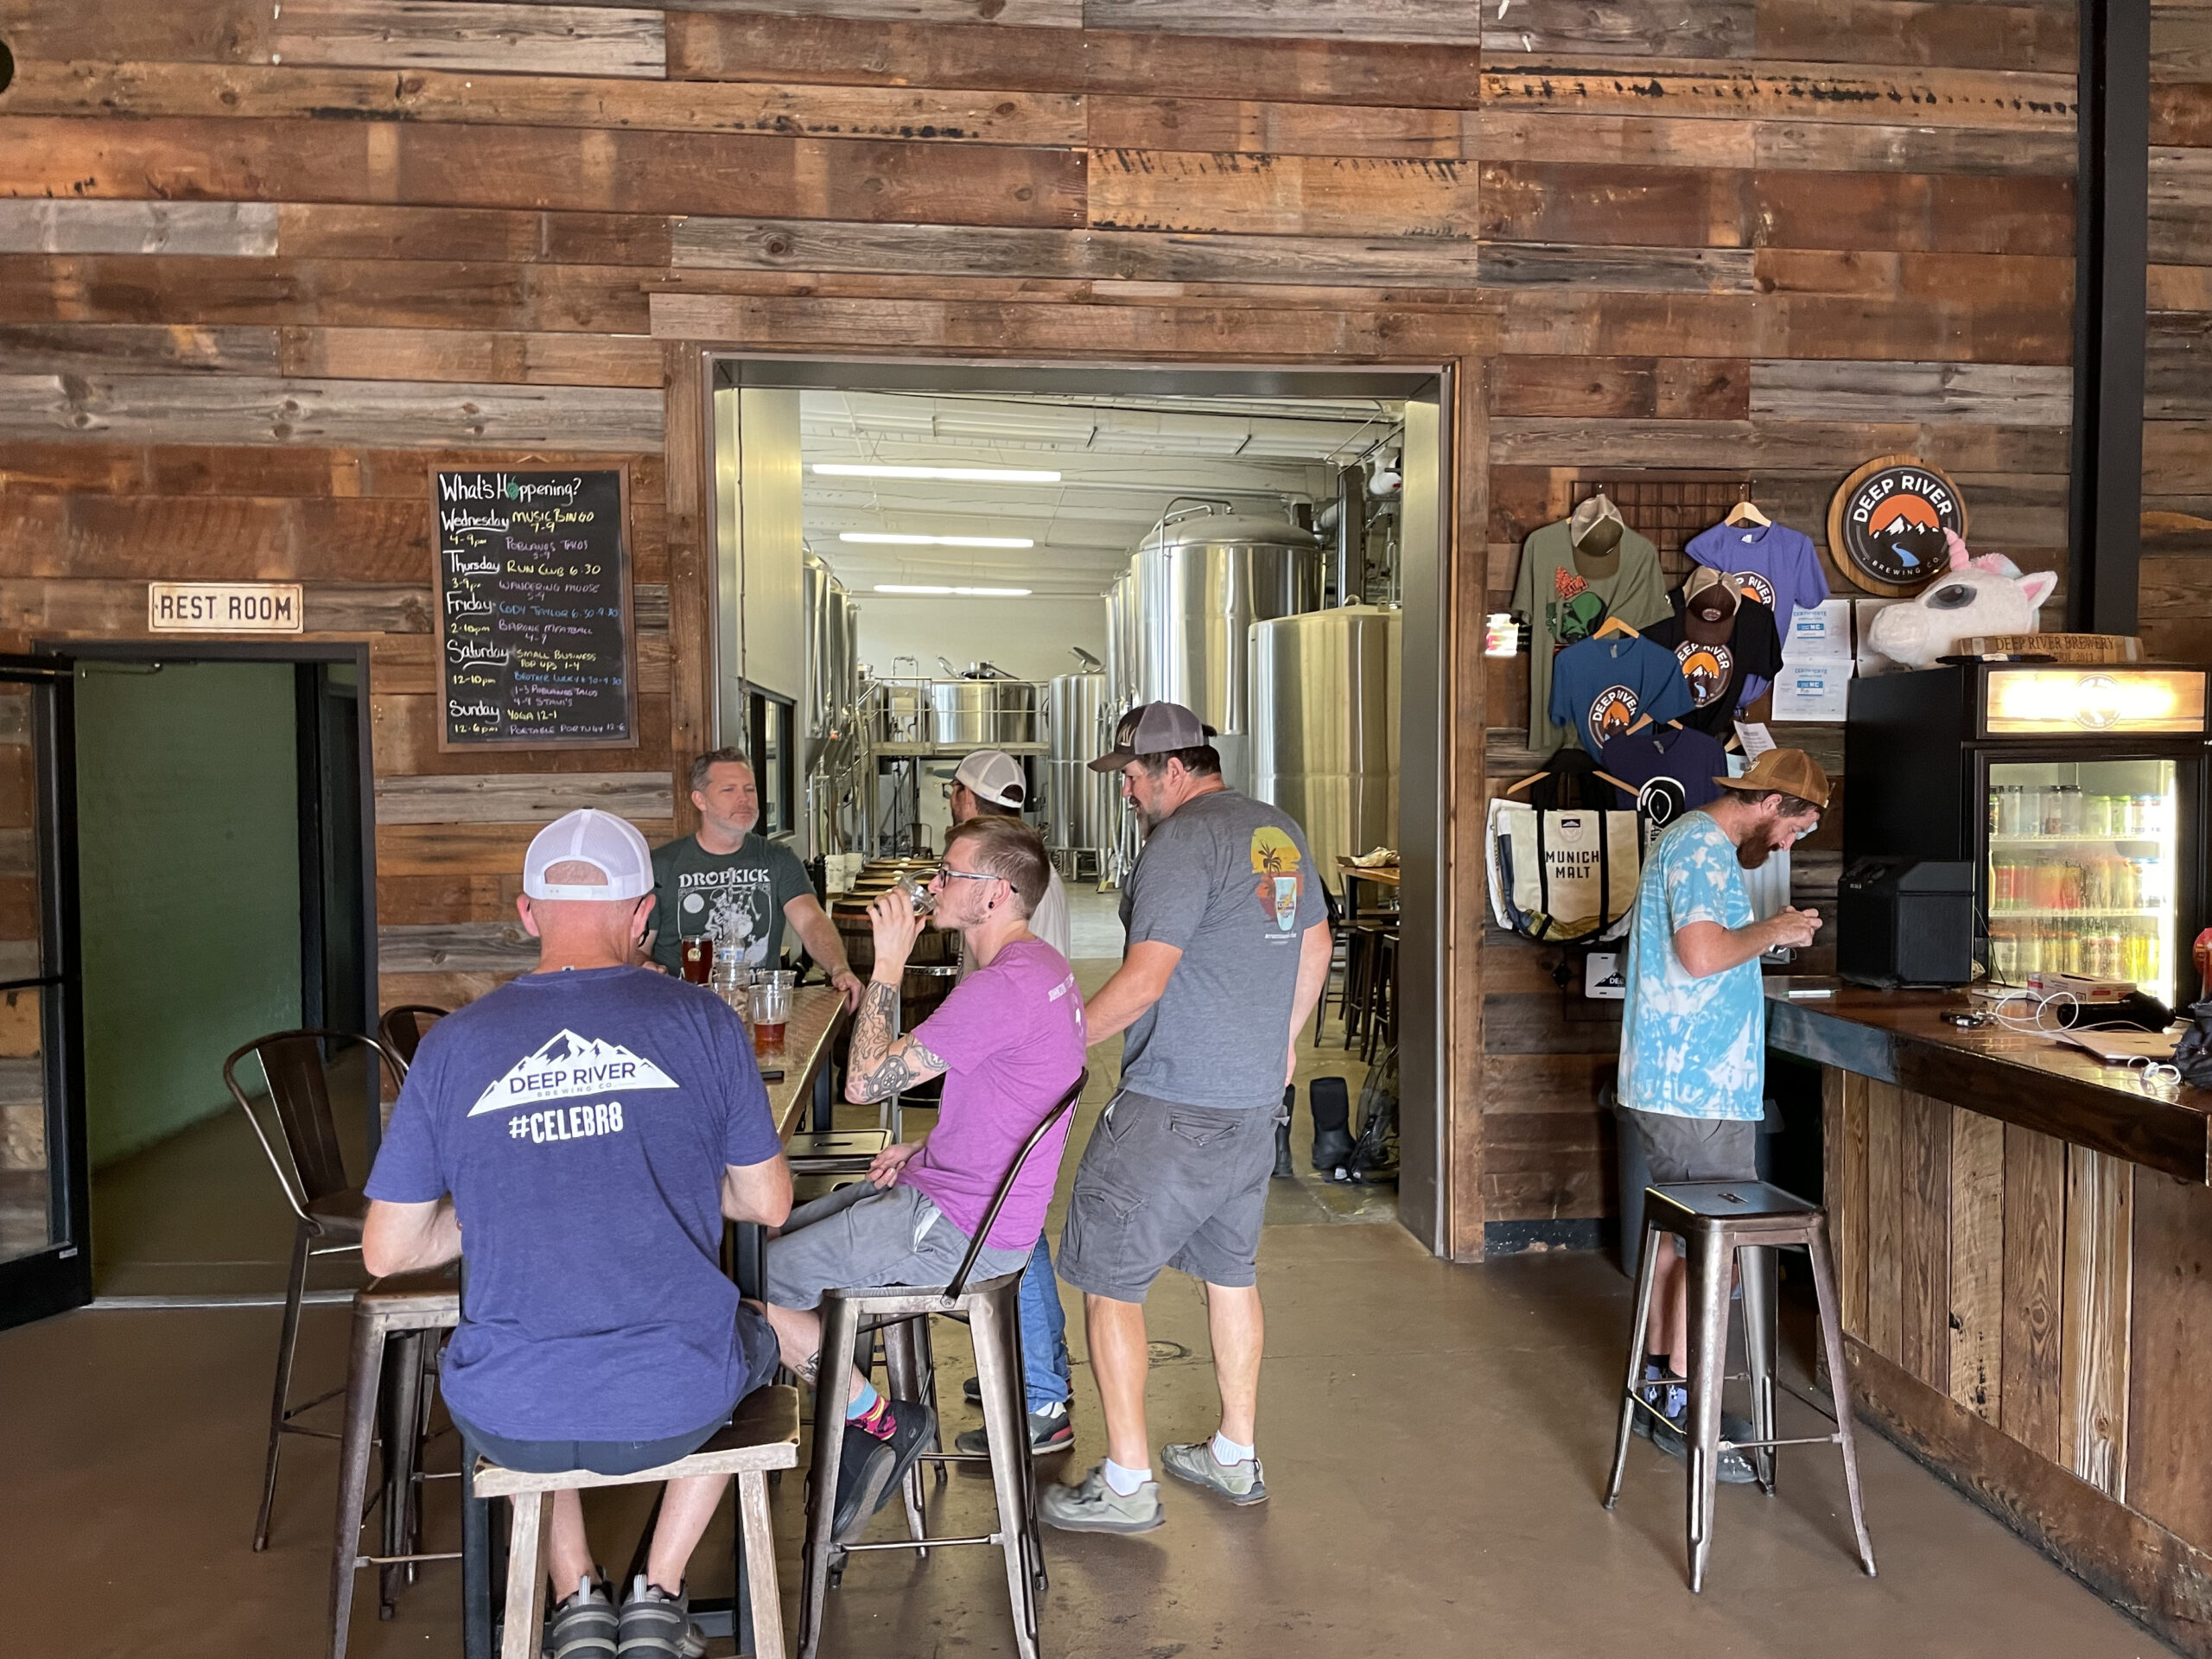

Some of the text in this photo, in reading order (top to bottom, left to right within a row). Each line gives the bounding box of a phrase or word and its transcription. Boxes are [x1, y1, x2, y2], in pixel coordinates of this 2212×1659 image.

[439, 473, 495, 501] What's
[1853, 475, 1953, 523] DEEP RIVER
[441, 507, 594, 533] Wednesday MUSIC BINGO
[442, 549, 500, 576] Thursday
[506, 559, 534, 573] RUN
[538, 563, 564, 577] CLUB
[1872, 560, 1921, 575] BREWING
[1748, 576, 1772, 605] RIVER
[161, 595, 291, 620] REST ROOM
[447, 590, 493, 619] Friday
[499, 601, 526, 615] CODY
[531, 605, 569, 618] TAYLOR
[447, 639, 509, 668] Saturday
[517, 649, 550, 659] SMALL
[1677, 643, 1700, 665] EEP
[1996, 636, 2114, 651] DEEP RIVER BREWERY
[449, 699, 500, 724] Sunday
[506, 709, 534, 721] YOGA
[1592, 692, 1616, 721] DEEP
[1545, 850, 1599, 863] MUNICH
[678, 868, 771, 887] DROPKICK
[1555, 866, 1591, 879] MALT
[510, 1062, 636, 1094] DEEP RIVER
[537, 1085, 592, 1098] BREWING
[508, 1101, 624, 1144] #CELEBR8
